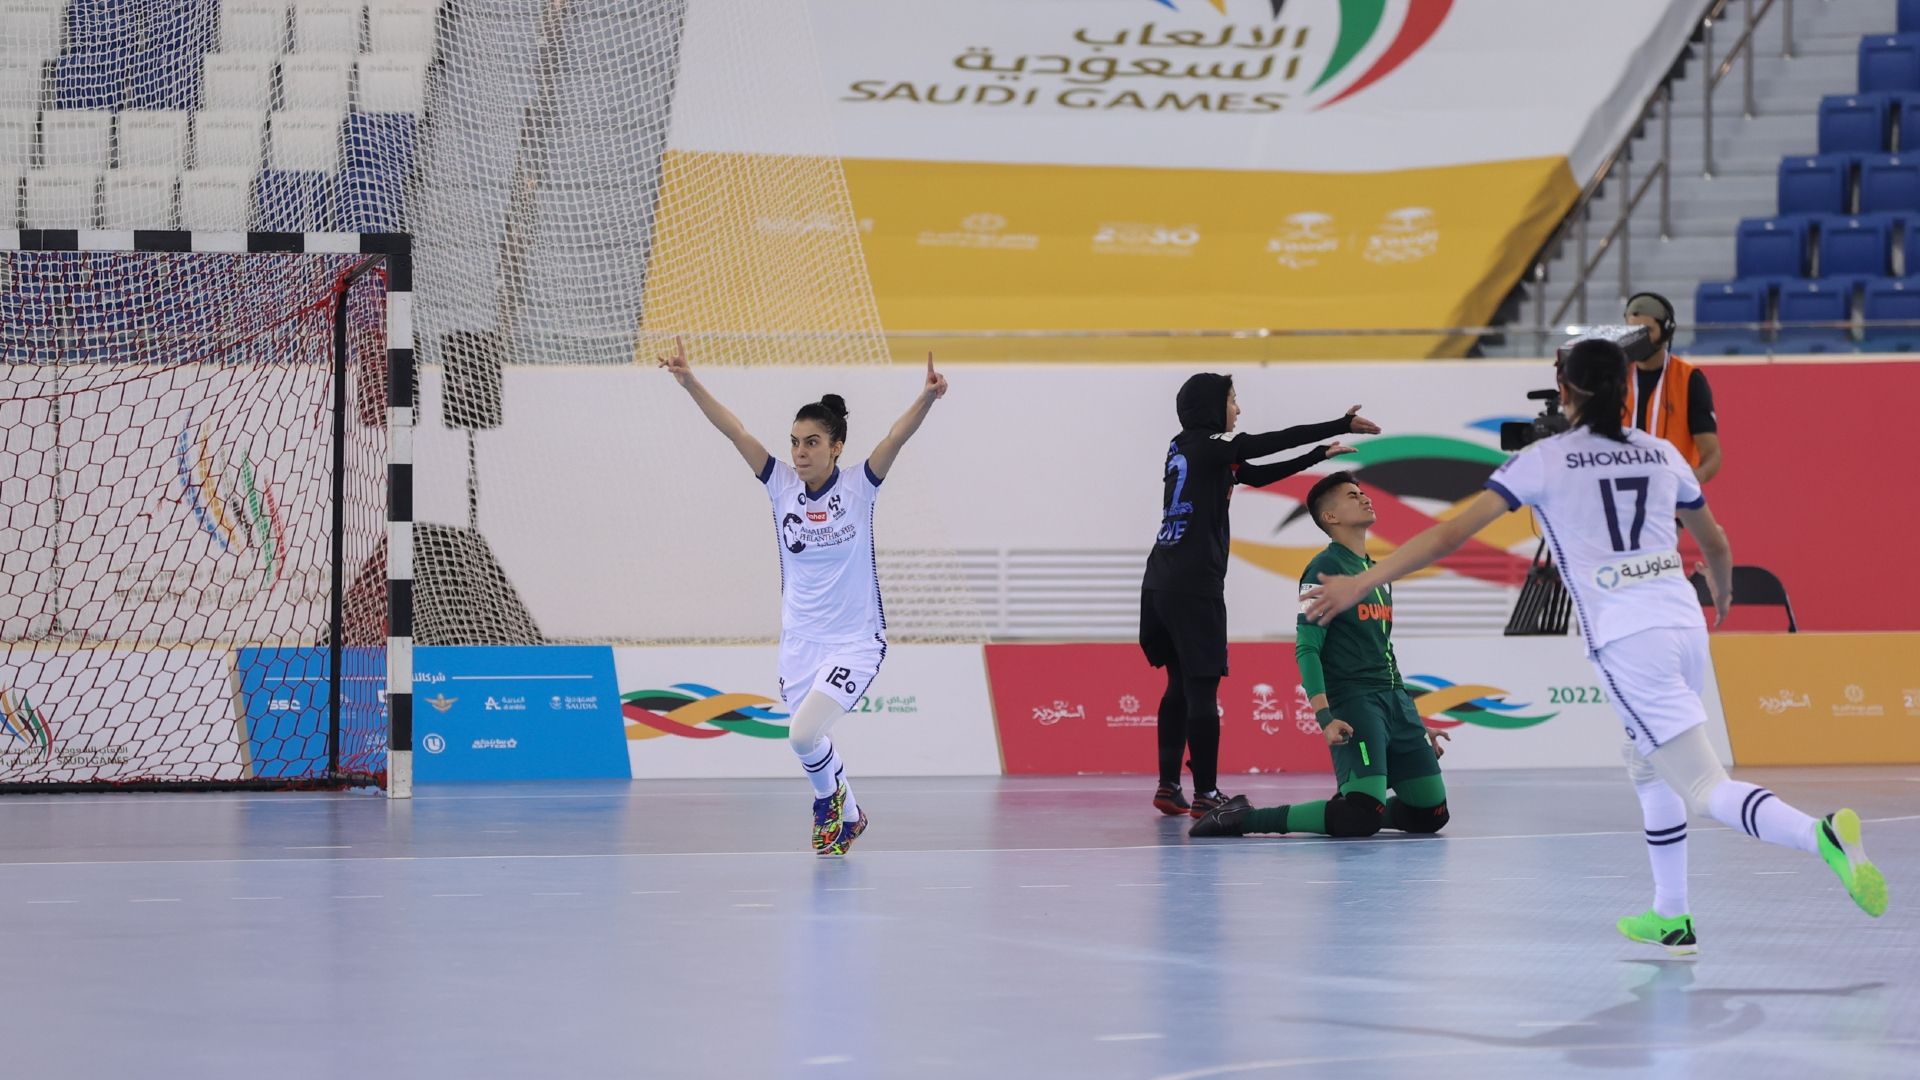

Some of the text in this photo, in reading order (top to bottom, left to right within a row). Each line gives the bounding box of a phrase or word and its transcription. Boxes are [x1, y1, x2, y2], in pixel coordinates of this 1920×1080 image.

[951, 46, 1302, 85] السعودية
[840, 80, 1288, 115] SAUDI GAMES
[1565, 449, 1669, 469] SHOKHAN
[1599, 476, 1650, 552] 17
[825, 665, 851, 689] 12
[1547, 686, 1602, 704] 2022
[1253, 709, 1283, 721] Saudi
[57, 756, 129, 766] SAUDI GAMES
